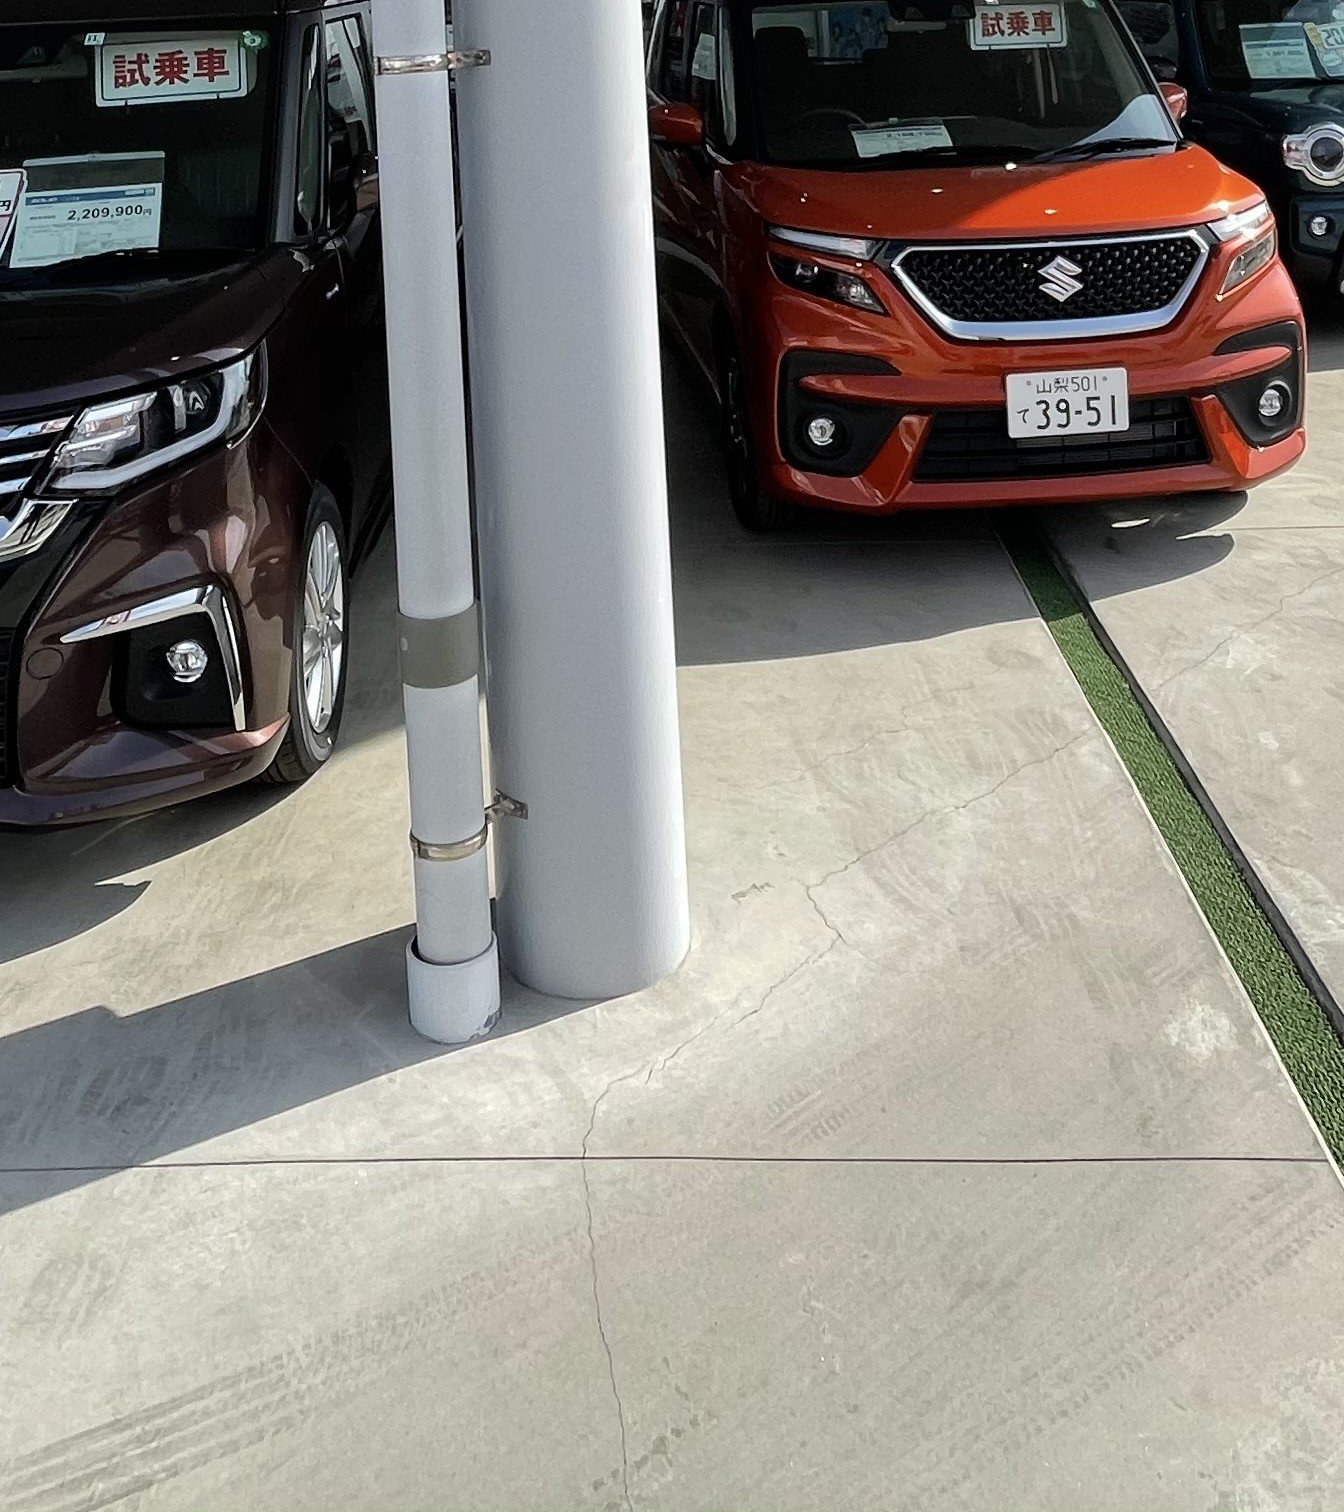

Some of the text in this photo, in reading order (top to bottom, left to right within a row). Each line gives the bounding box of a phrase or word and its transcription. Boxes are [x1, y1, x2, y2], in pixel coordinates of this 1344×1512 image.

[981, 10, 1056, 37] 試乗車
[113, 47, 230, 89] 試乗車
[1036, 395, 1117, 430] 39-51
